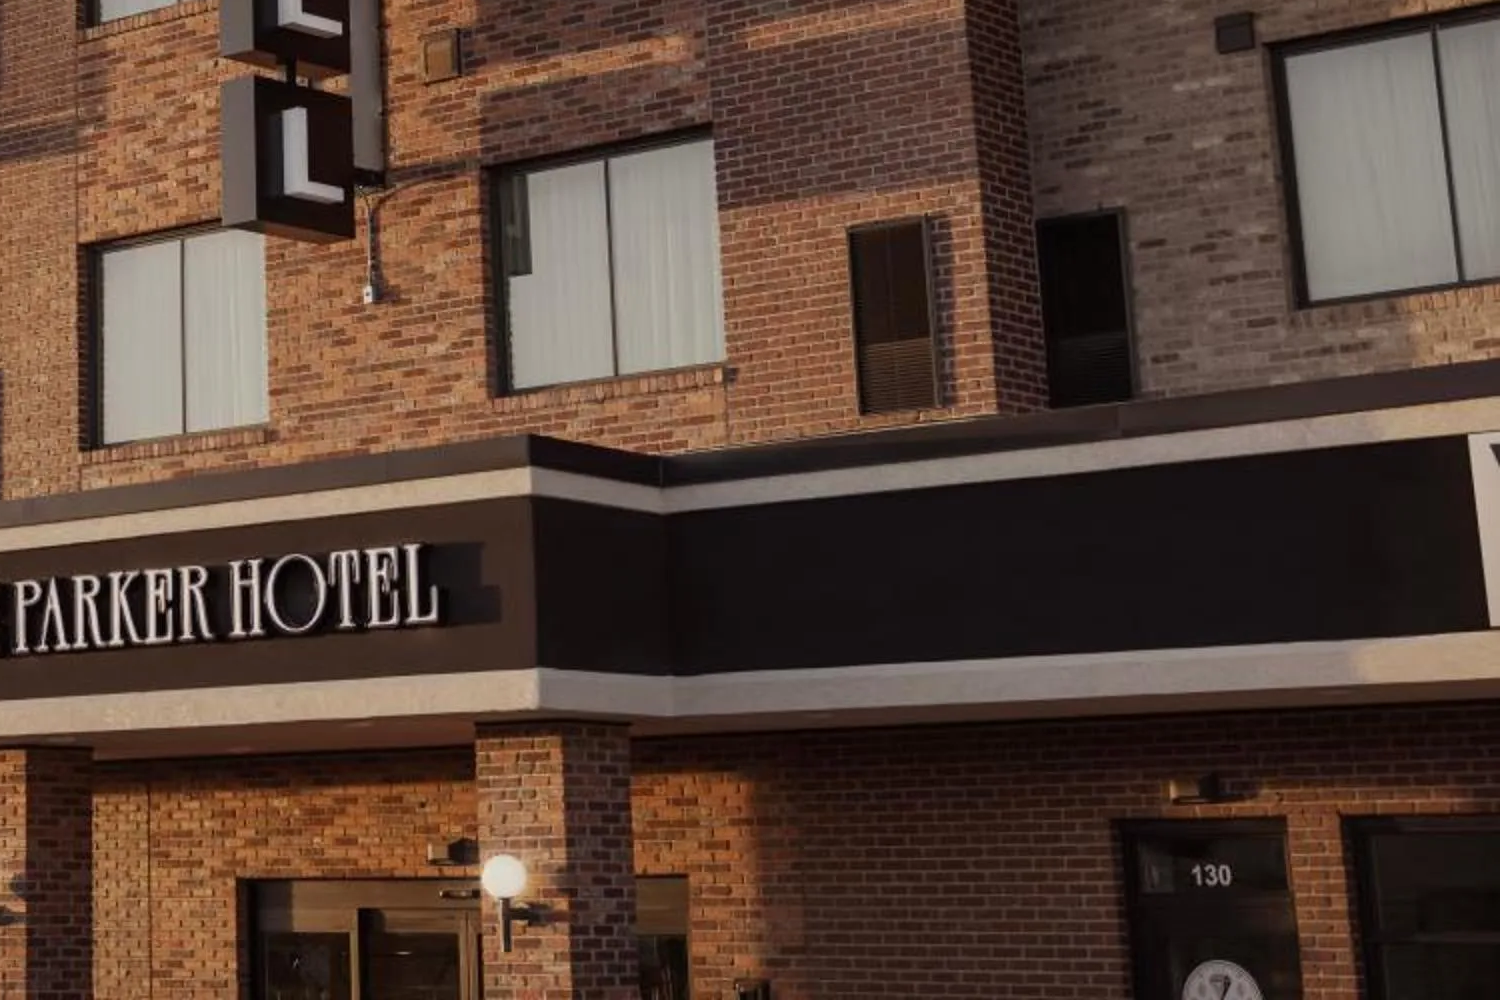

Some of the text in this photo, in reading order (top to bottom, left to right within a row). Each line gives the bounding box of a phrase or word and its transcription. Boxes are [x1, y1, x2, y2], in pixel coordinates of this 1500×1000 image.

[11, 564, 215, 655] PARKER
[228, 543, 439, 639] HOTEL
[1191, 863, 1233, 887] 130
